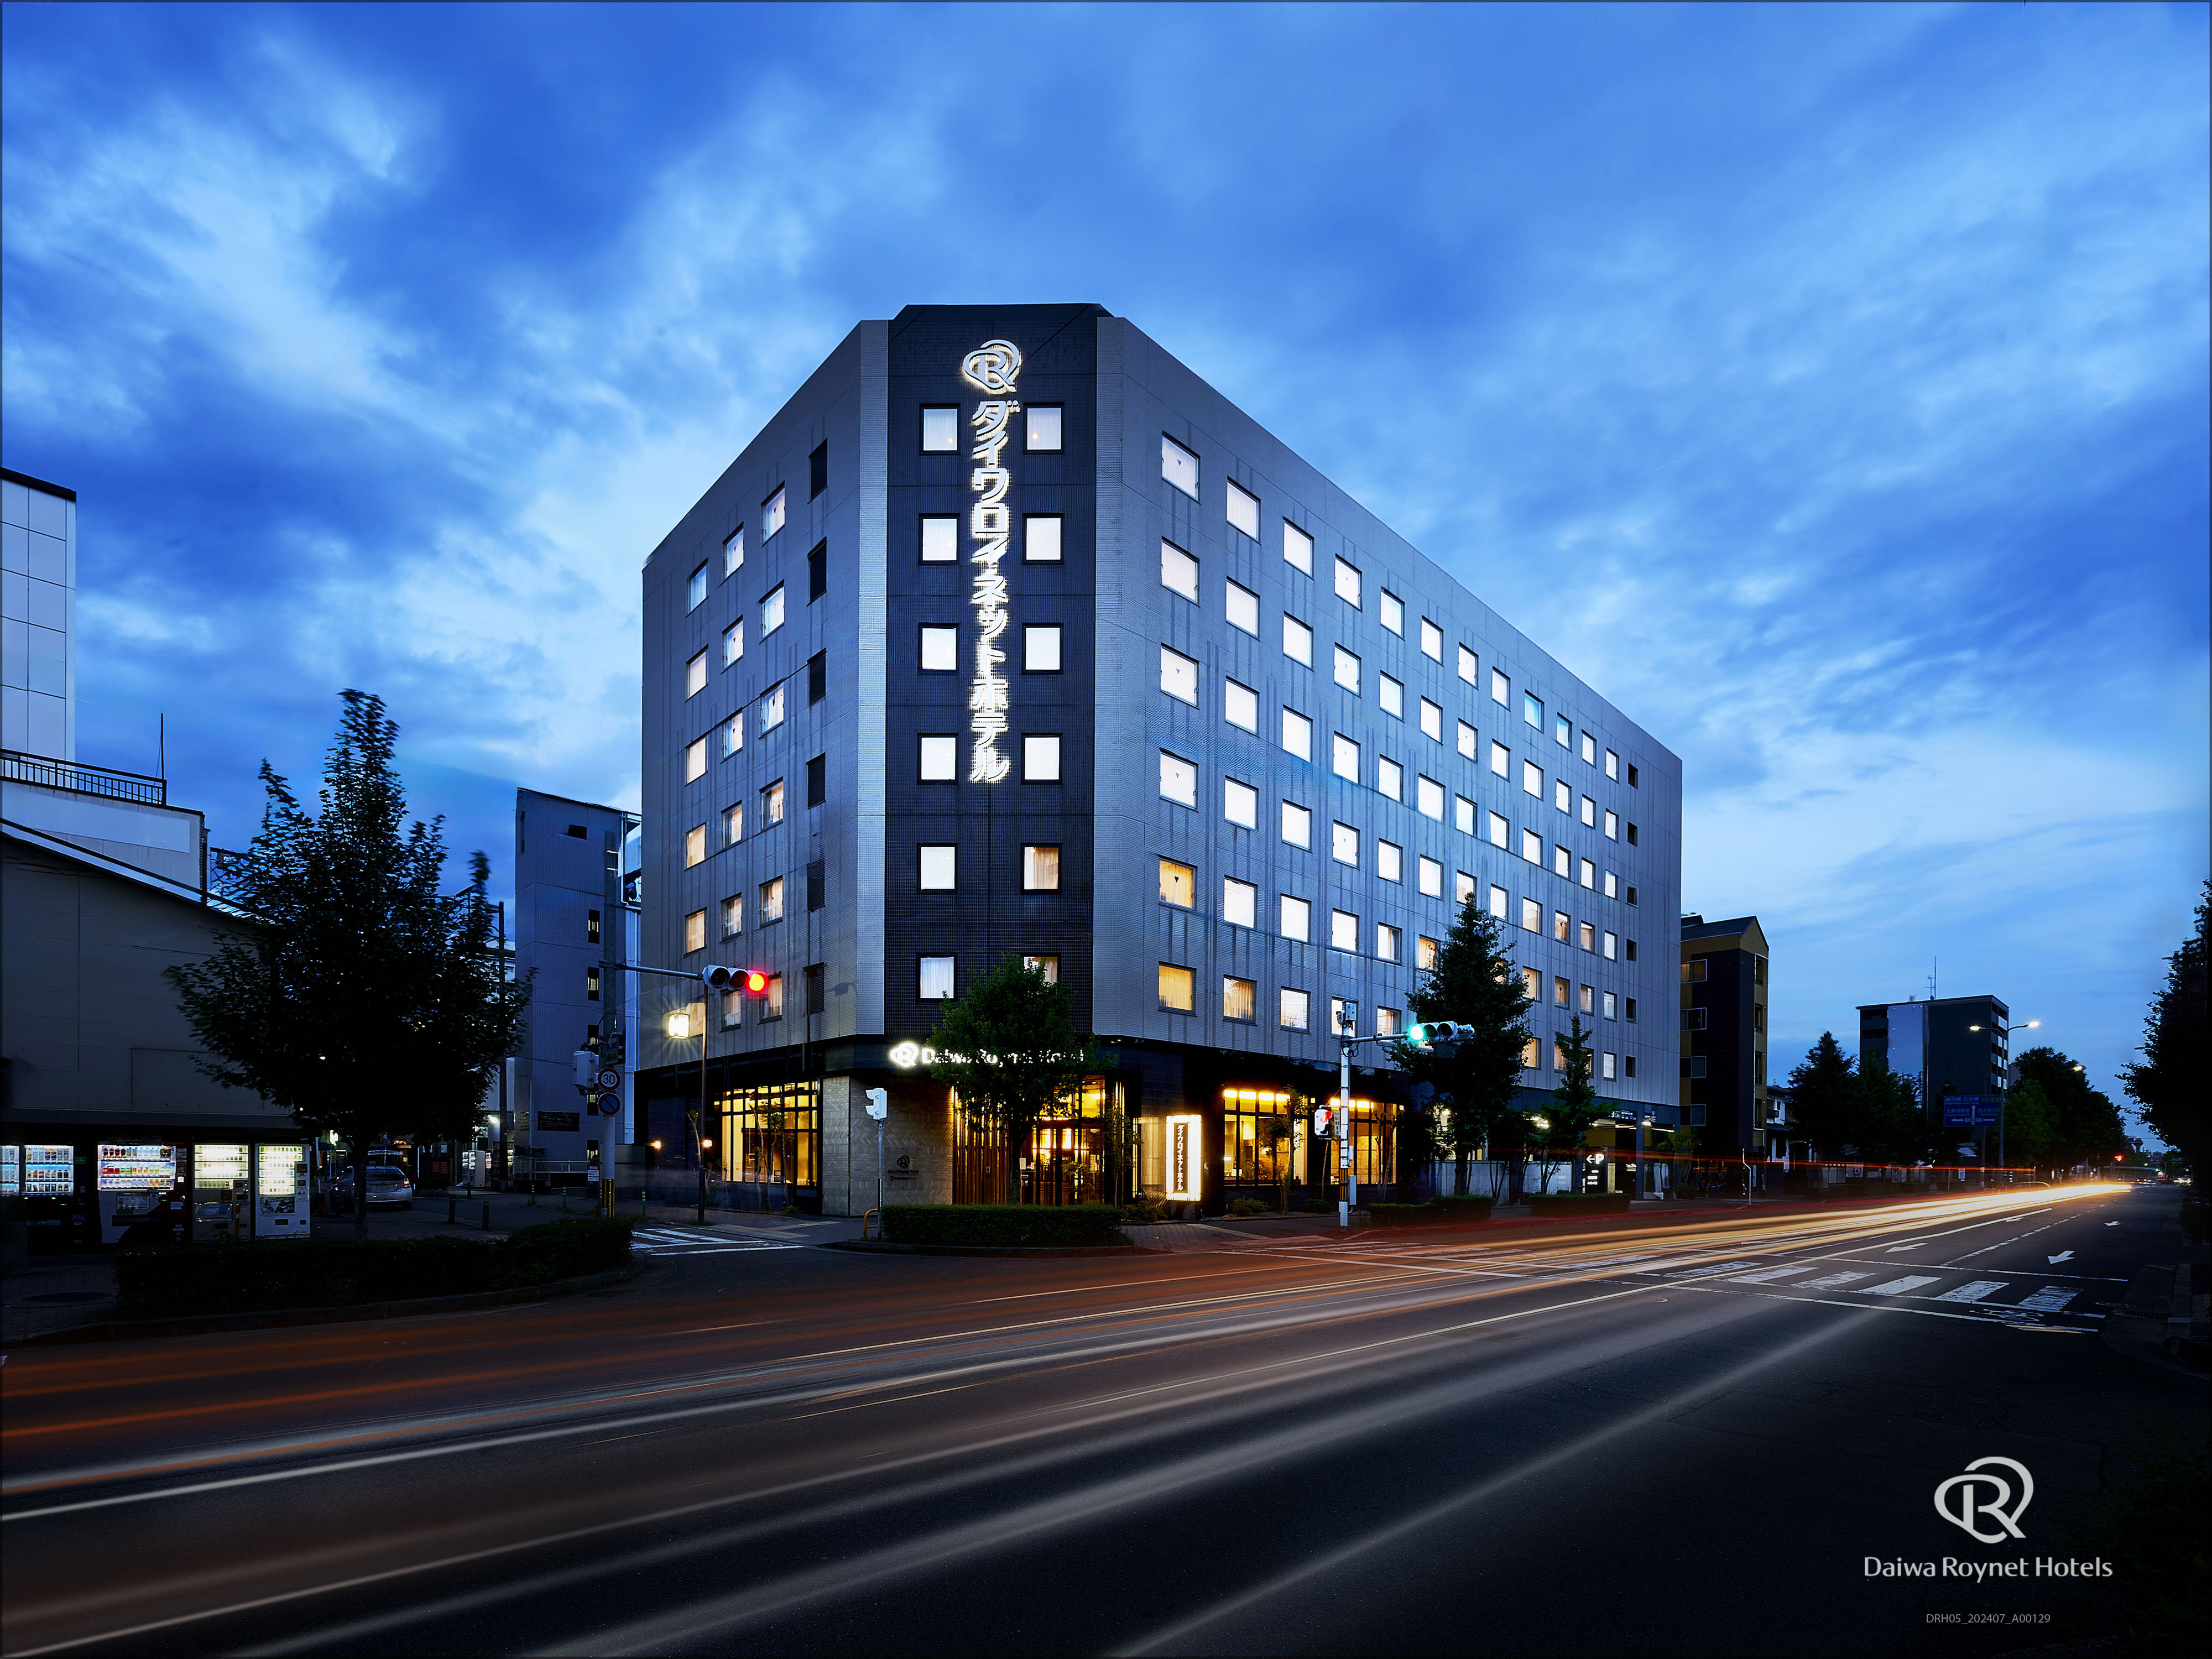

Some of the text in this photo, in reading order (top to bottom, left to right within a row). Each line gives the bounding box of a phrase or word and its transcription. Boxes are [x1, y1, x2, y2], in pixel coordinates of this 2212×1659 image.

[971, 400, 1020, 784] ダイワロイネットホテル
[603, 1074, 615, 1084] 30
[1595, 1153, 1605, 1165] P
